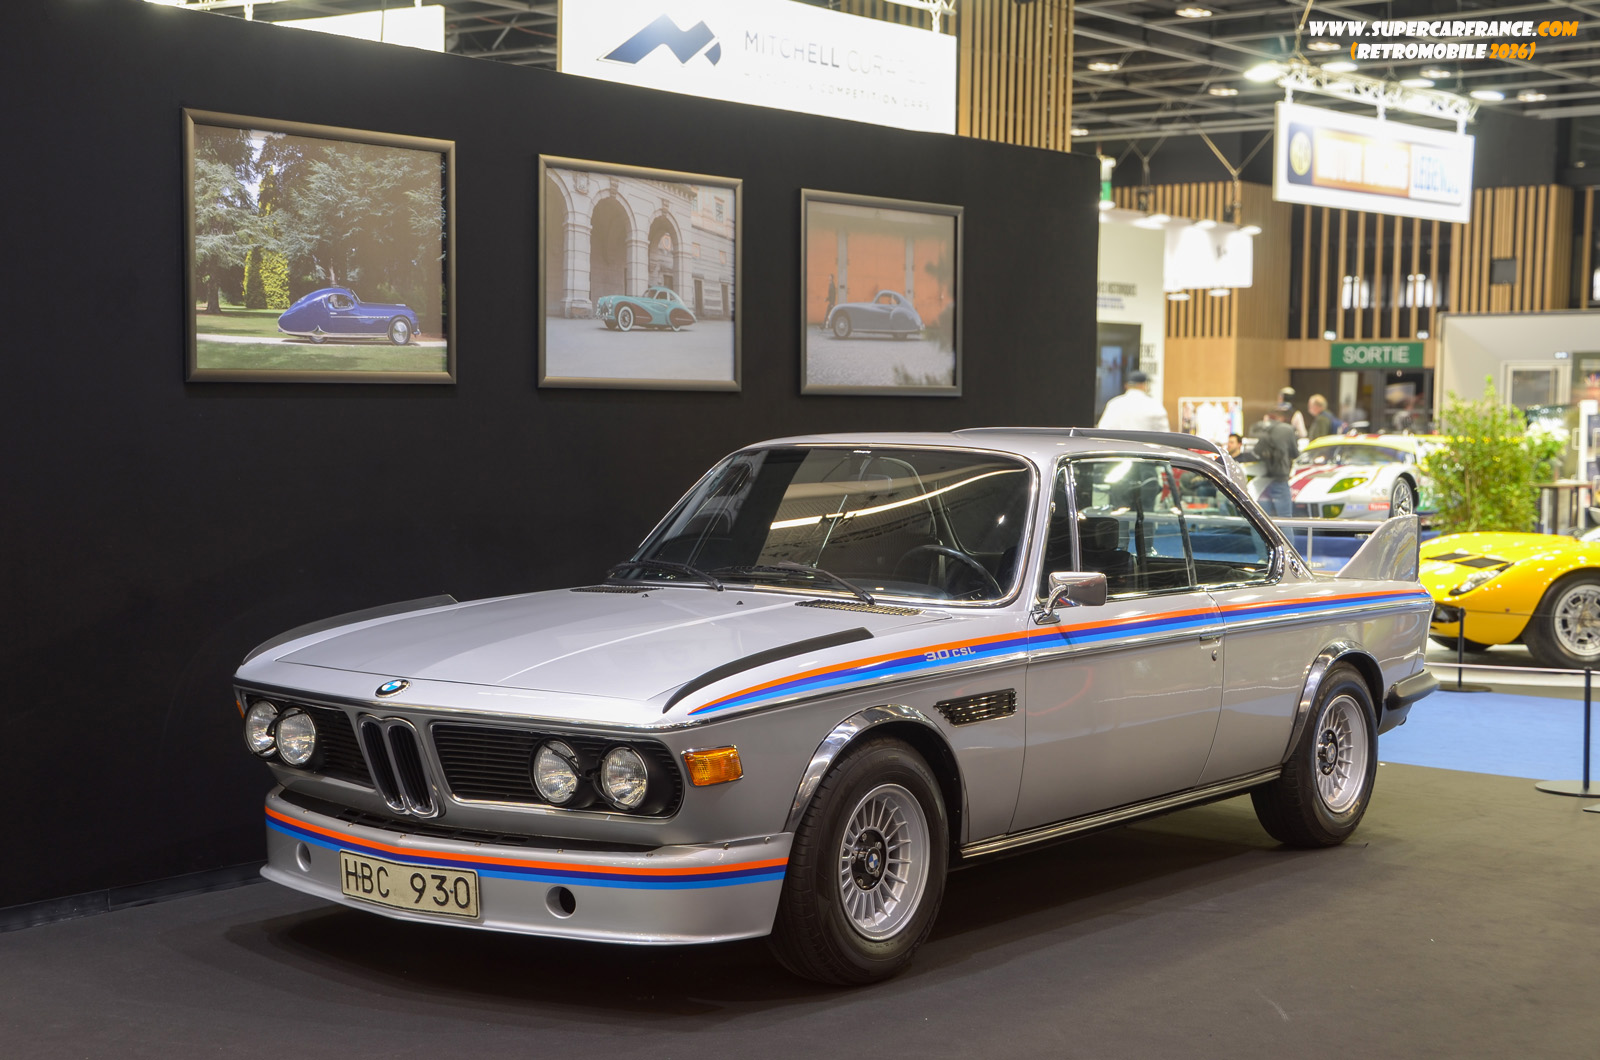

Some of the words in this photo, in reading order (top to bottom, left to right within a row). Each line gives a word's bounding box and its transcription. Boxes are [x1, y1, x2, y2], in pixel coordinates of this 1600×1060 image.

[745, 29, 840, 69] MITCHELL
[1343, 345, 1410, 364] SORTIE
[952, 646, 976, 658] CSL
[344, 858, 390, 899] HBC
[409, 872, 471, 910] 930
